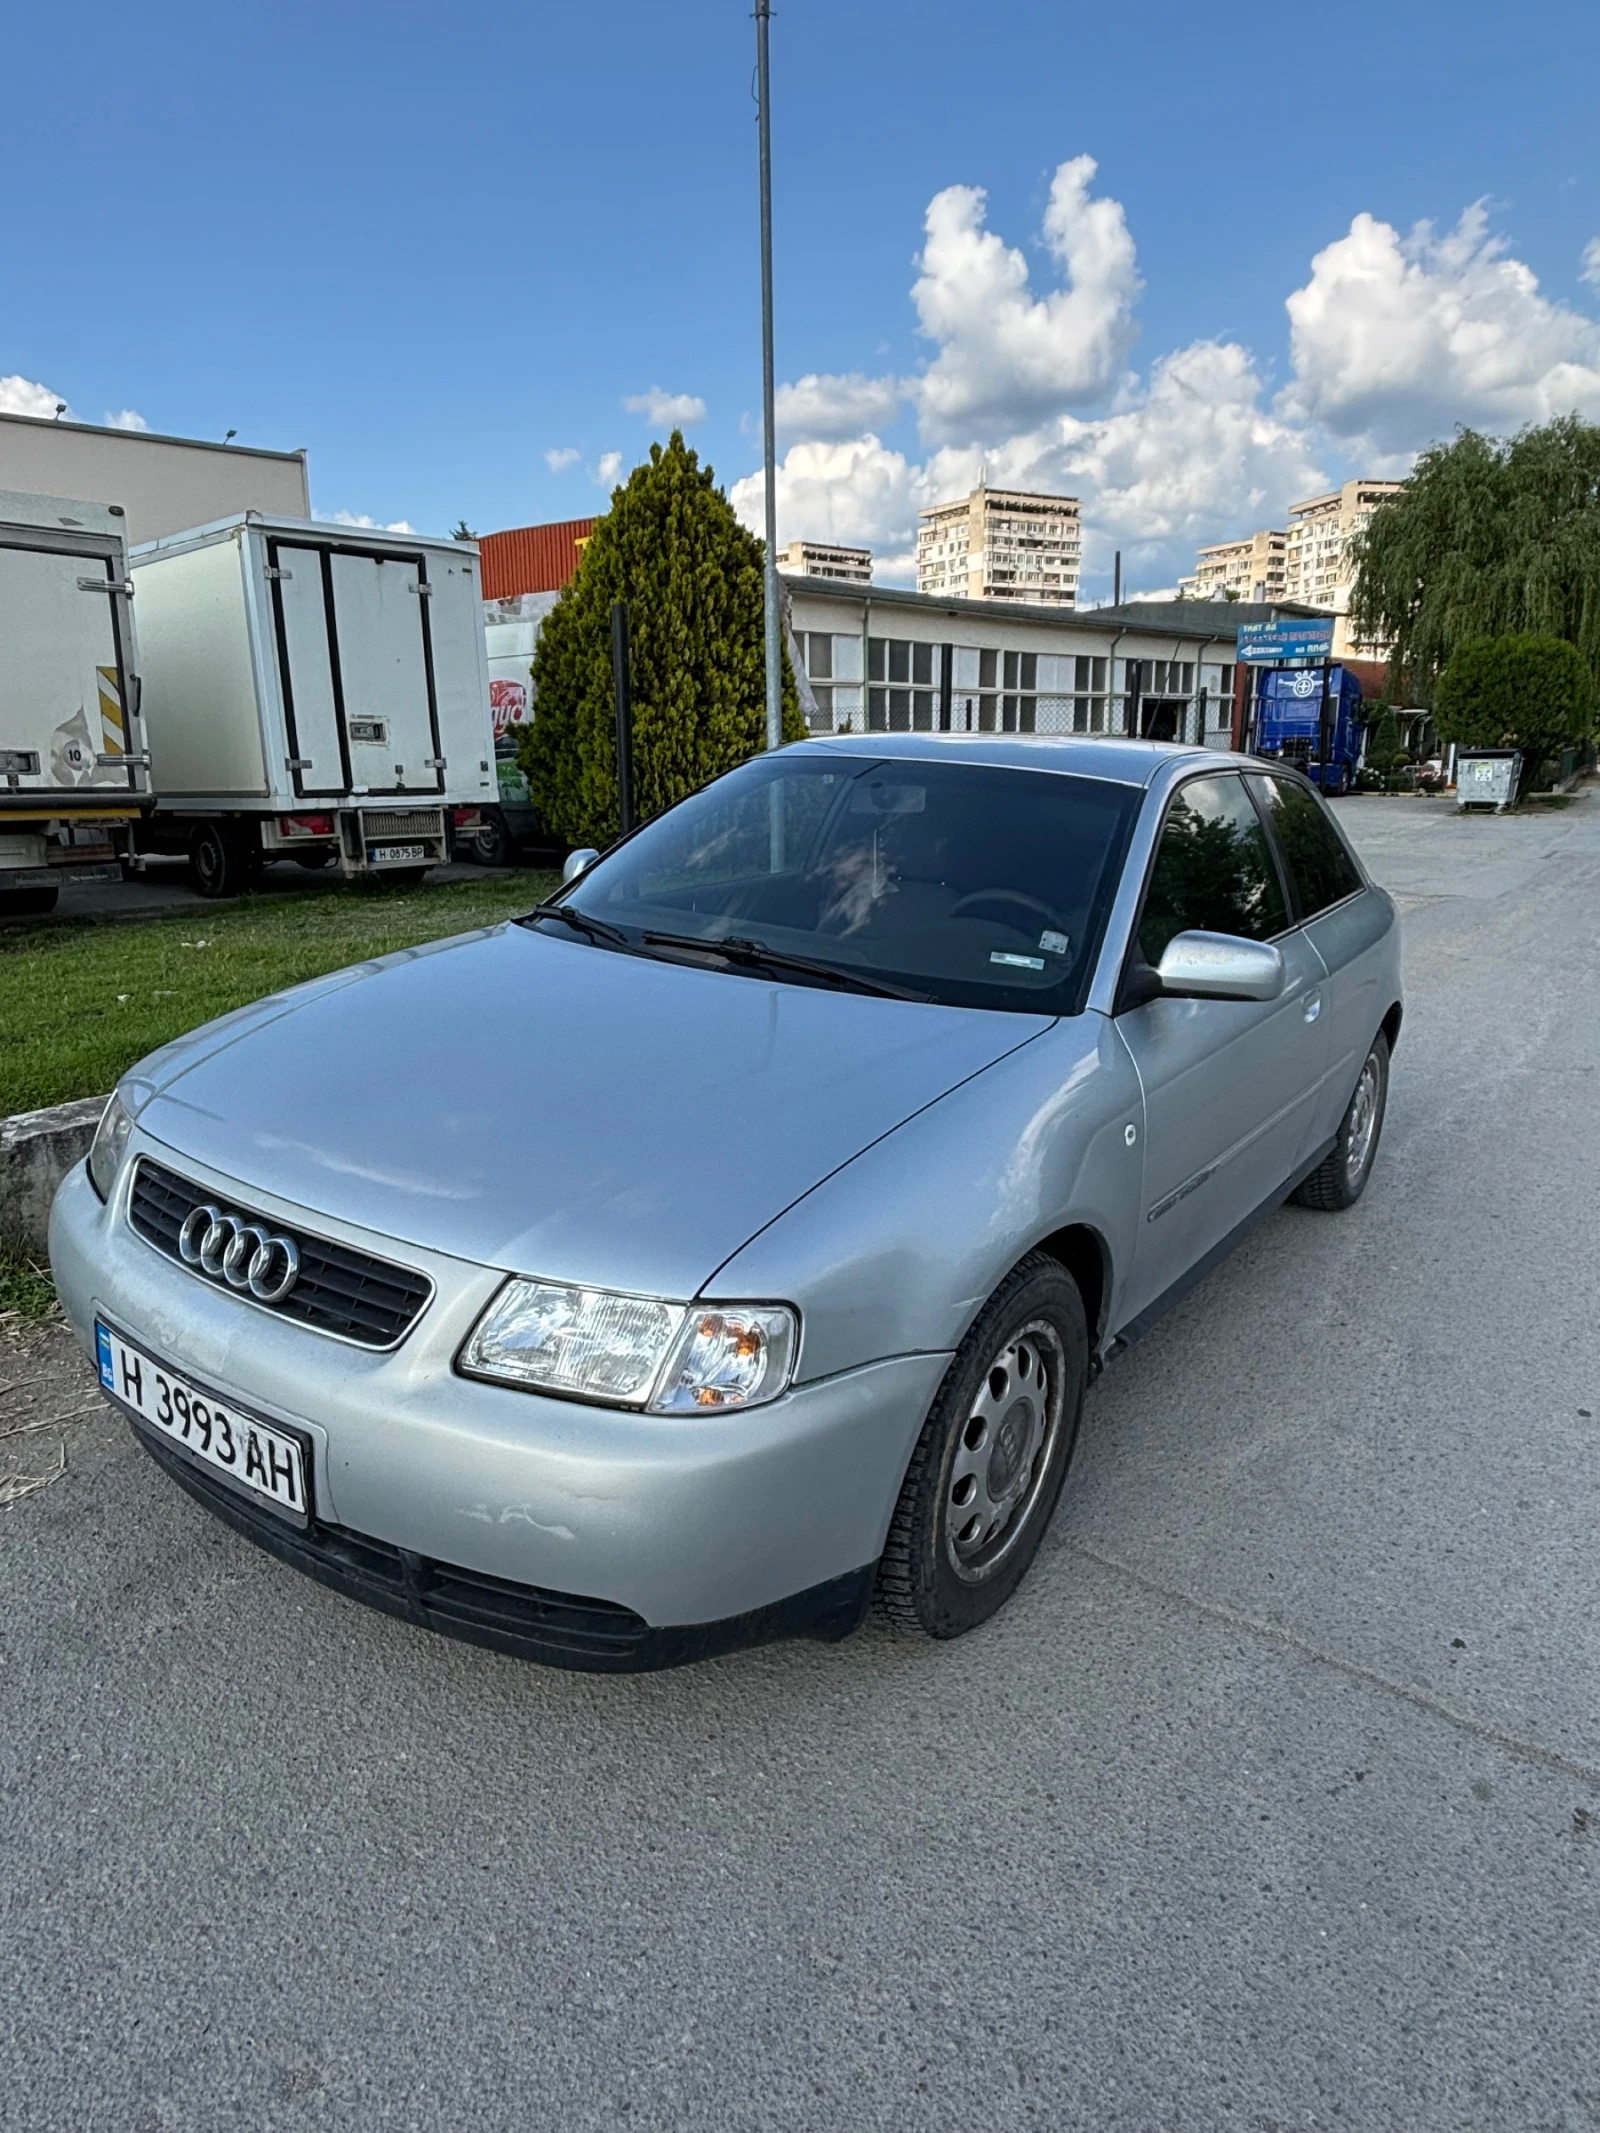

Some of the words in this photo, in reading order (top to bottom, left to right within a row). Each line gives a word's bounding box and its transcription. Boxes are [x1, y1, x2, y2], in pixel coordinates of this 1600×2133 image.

[1294, 669, 1316, 680] DAF
[68, 749, 81, 762] 10
[379, 849, 387, 860] H
[390, 848, 411, 859] 0875
[411, 846, 423, 858] BP
[120, 1348, 143, 1407] H
[155, 1373, 237, 1465] 3993
[246, 1426, 297, 1503] AH
